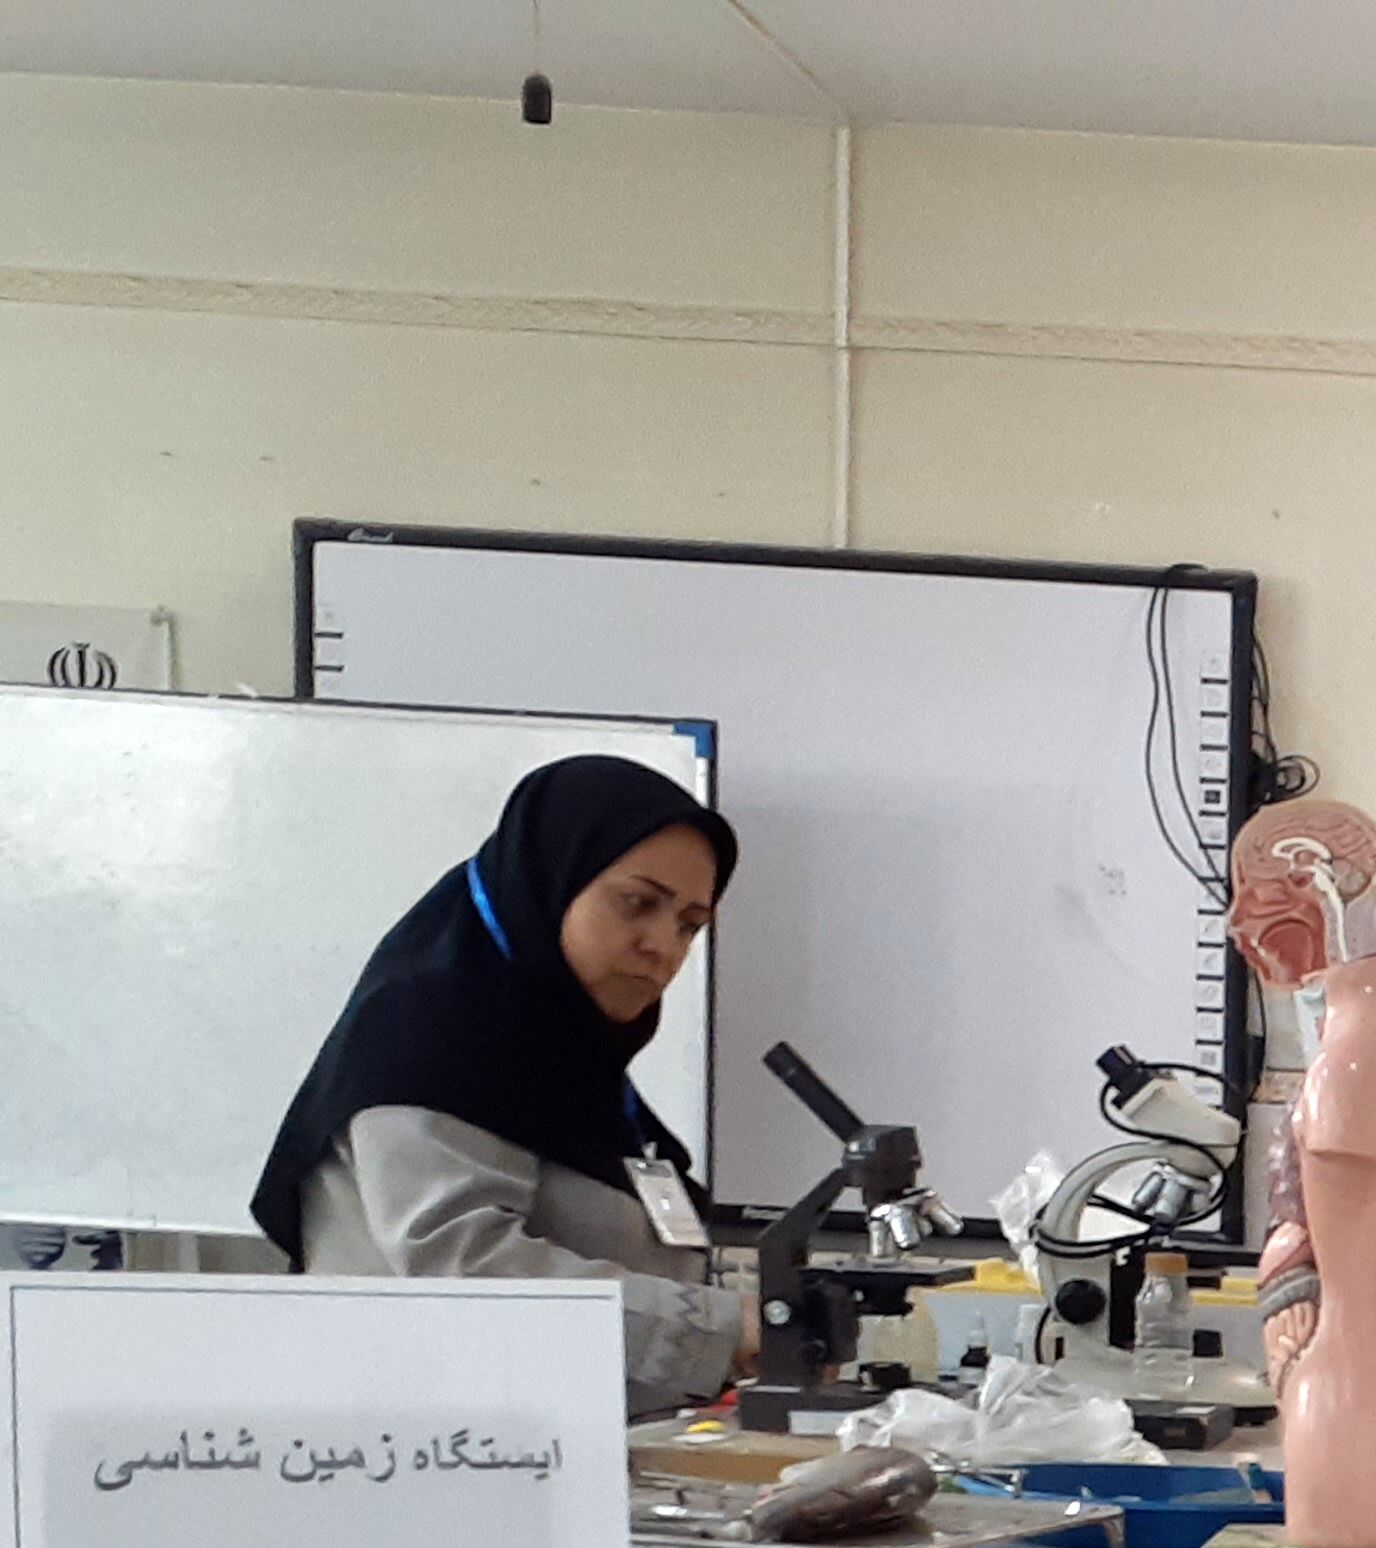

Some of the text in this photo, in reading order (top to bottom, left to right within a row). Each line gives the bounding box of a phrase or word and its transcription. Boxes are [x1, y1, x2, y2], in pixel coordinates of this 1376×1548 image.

[93, 1427, 563, 1492] ایستگاه زمین شناسی
